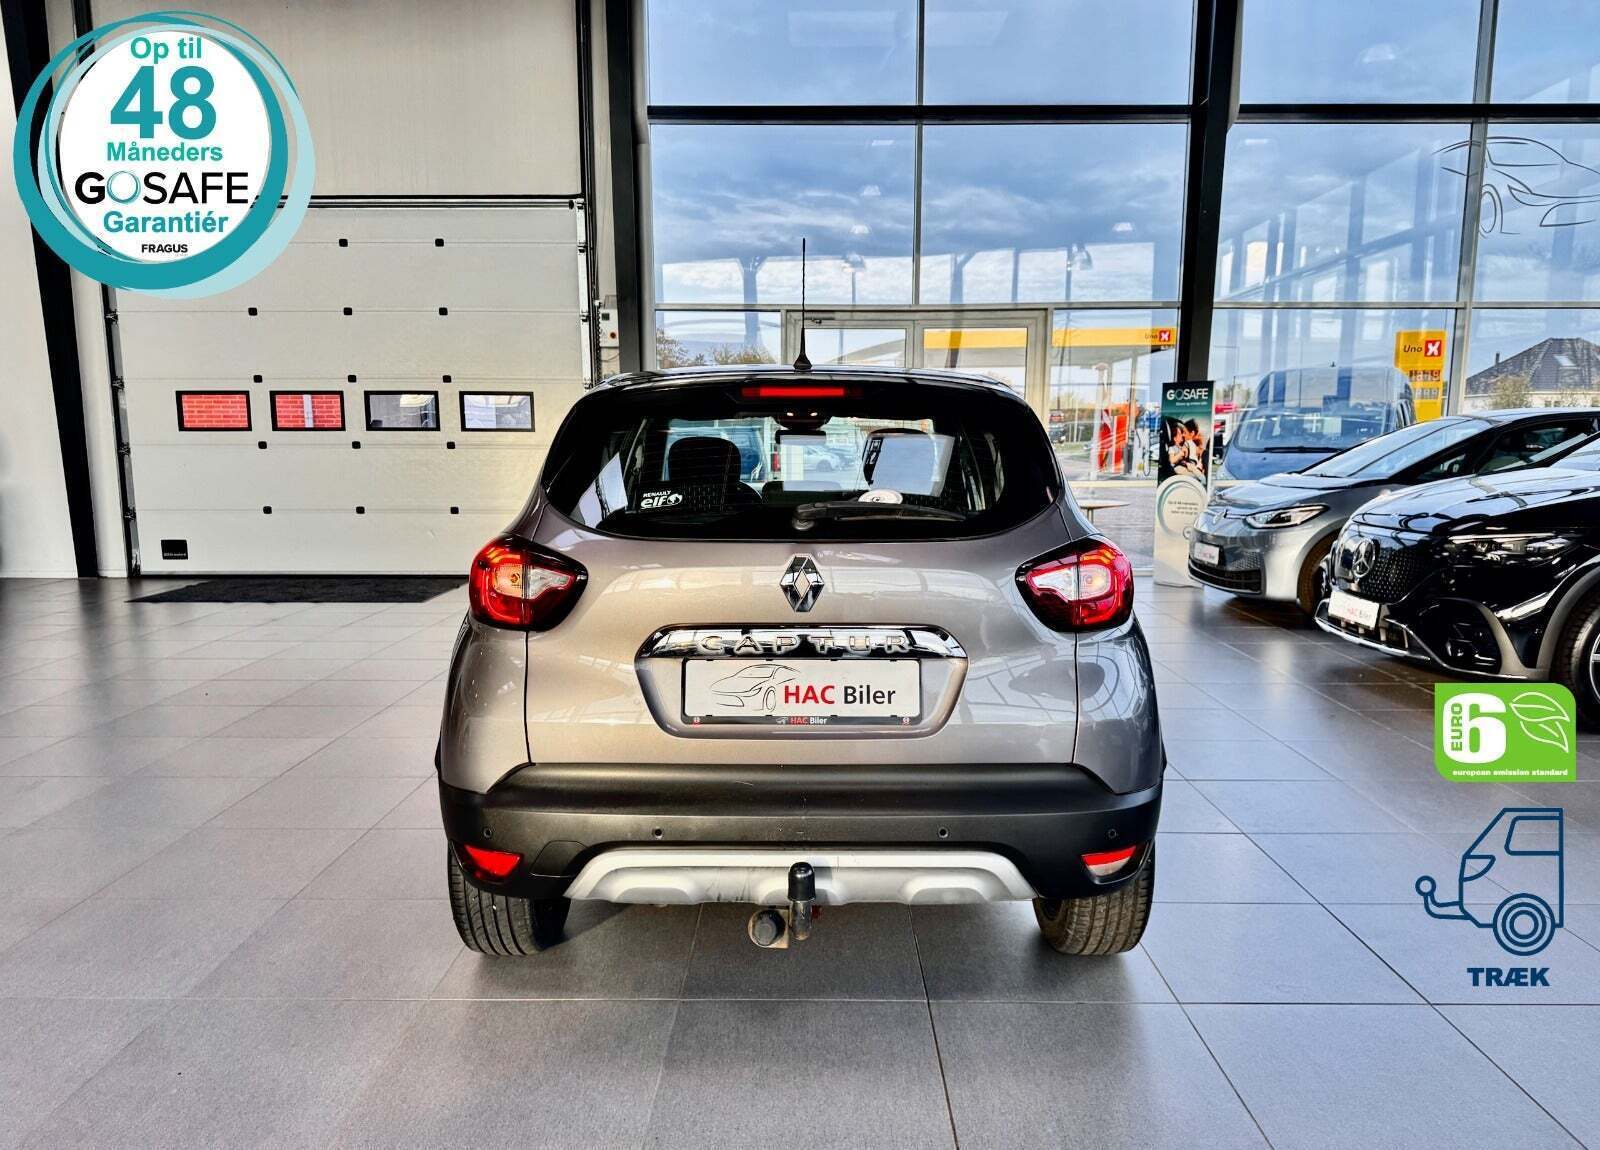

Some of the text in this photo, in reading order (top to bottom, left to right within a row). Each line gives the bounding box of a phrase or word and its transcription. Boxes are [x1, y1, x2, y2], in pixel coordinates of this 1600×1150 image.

[1403, 344, 1423, 353] Uno
[1166, 388, 1209, 401] GOSAFE
[643, 490, 671, 498] RENAULT
[640, 495, 668, 509] elf
[698, 634, 911, 654] CAPTUR
[783, 684, 897, 705] HAC Biler
[790, 716, 827, 725] HAC Biler
